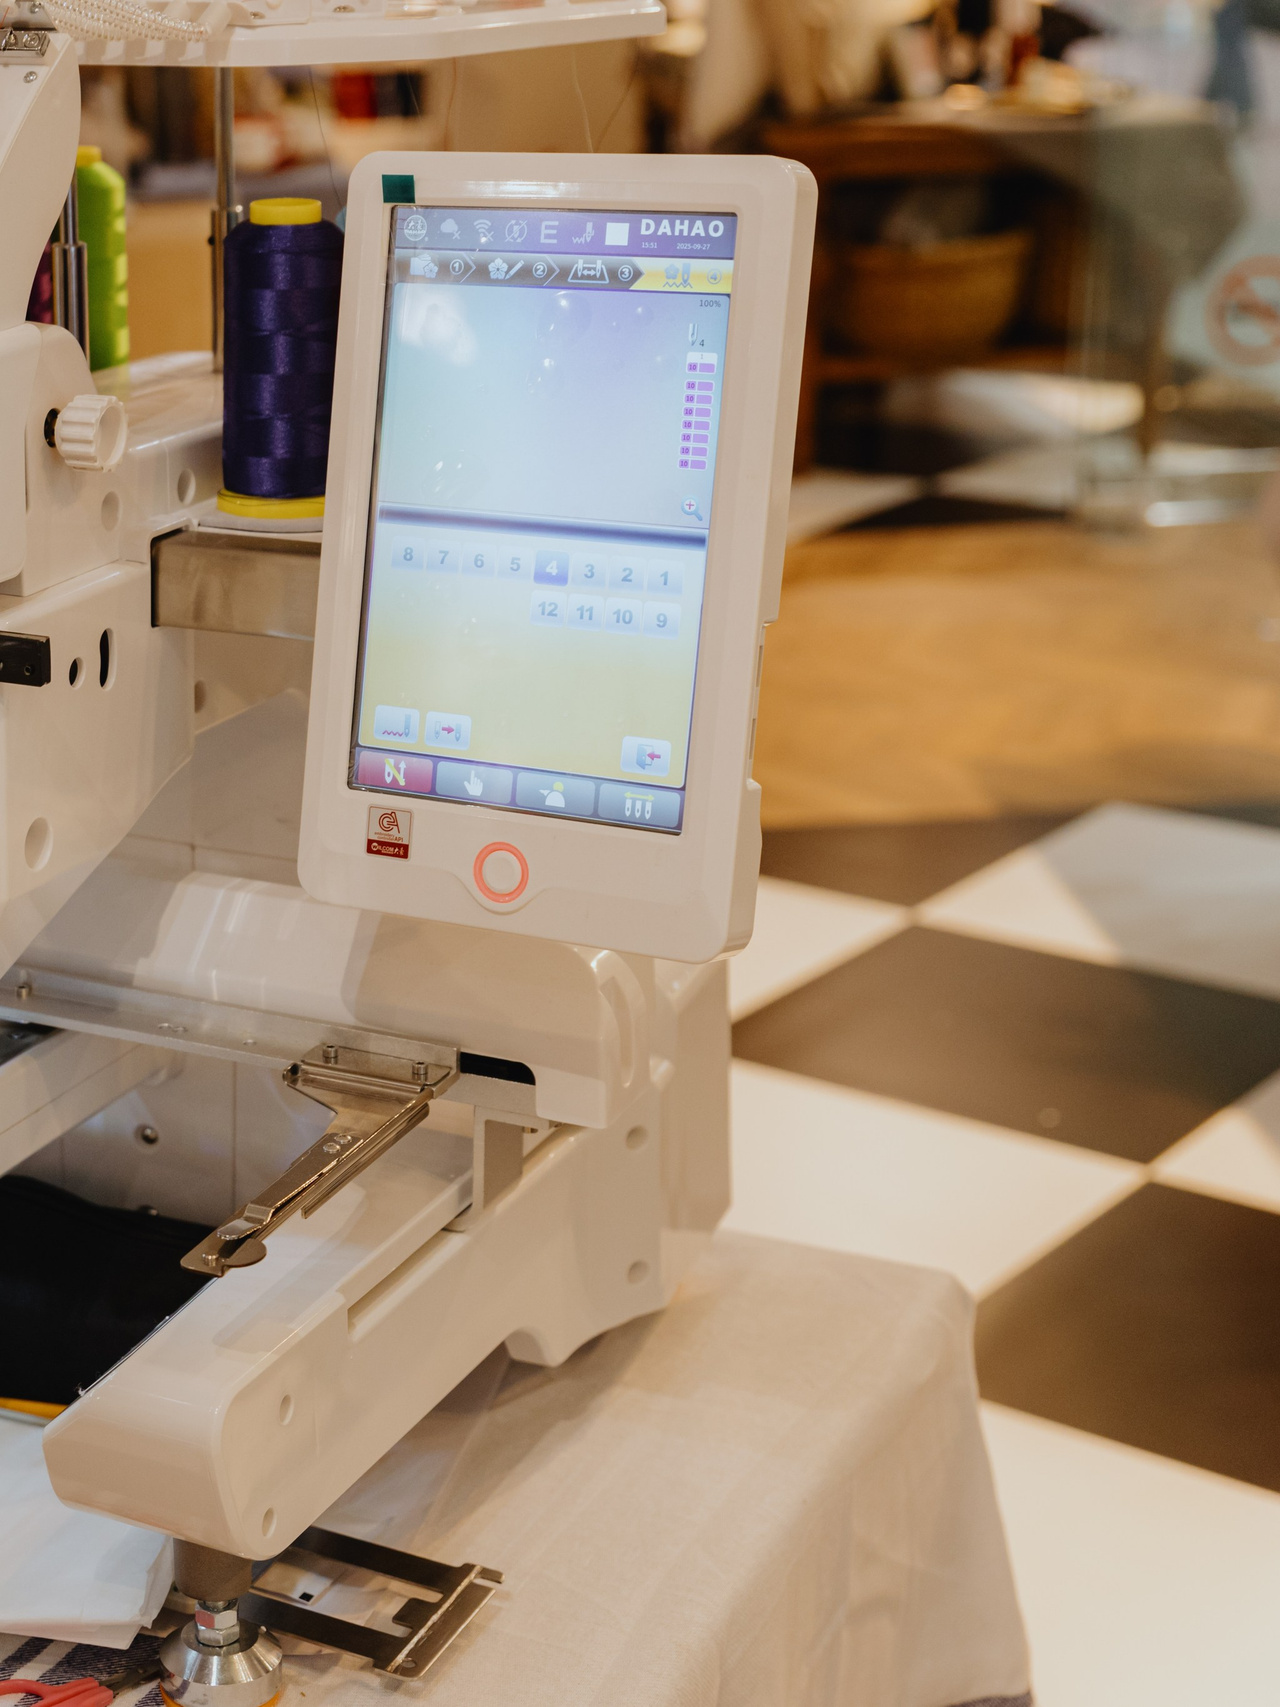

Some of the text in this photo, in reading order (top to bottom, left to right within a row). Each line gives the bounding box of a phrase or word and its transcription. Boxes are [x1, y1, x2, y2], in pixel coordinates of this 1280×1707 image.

[540, 220, 559, 243] E
[640, 218, 725, 237] DAHAO
[641, 241, 711, 250] 15:51 2025-09-27
[699, 299, 722, 308] 100%
[402, 546, 669, 586] 8 7 6 5 4 3 2 1
[537, 601, 668, 629] 12 11 10 9
